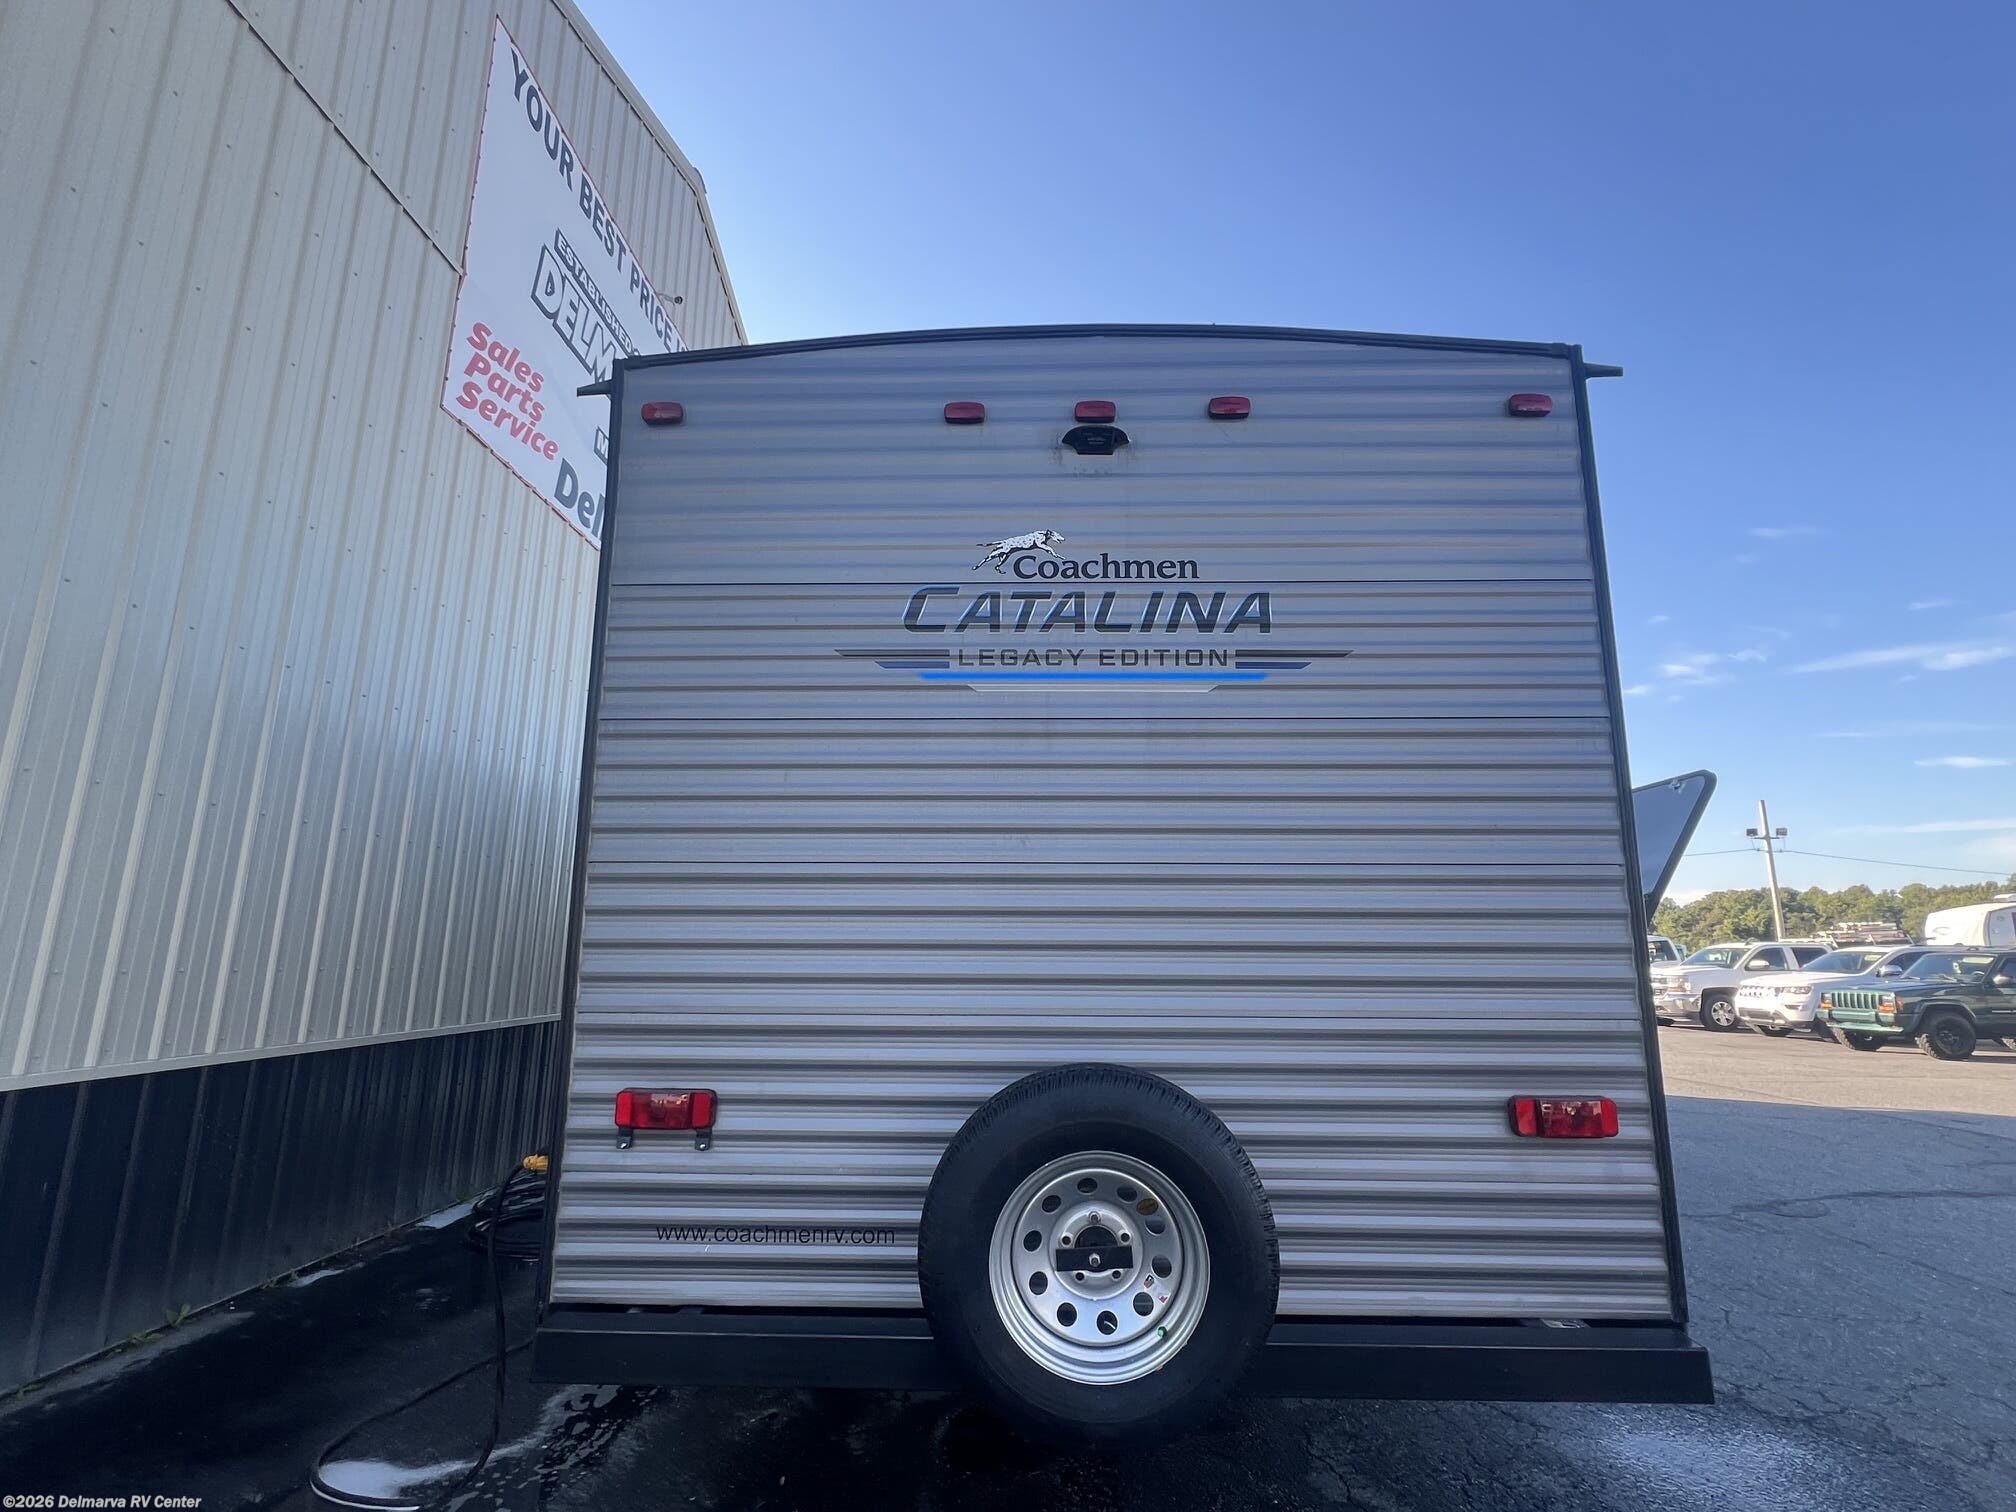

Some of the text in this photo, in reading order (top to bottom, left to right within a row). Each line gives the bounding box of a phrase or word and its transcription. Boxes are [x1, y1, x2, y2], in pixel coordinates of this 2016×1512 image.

[511, 47, 672, 353] YOUR BEST PRICE
[558, 237, 633, 354] ESTABLISHED
[464, 352, 545, 422] Parts
[467, 322, 545, 394] Sales
[456, 380, 559, 461] Service
[554, 457, 605, 538] Del
[1013, 552, 1200, 579] Coachmen
[901, 585, 1273, 634] CATALINA
[958, 648, 1229, 667] LEGACY EDITION
[656, 1224, 896, 1245] www.coachmenrv.com
